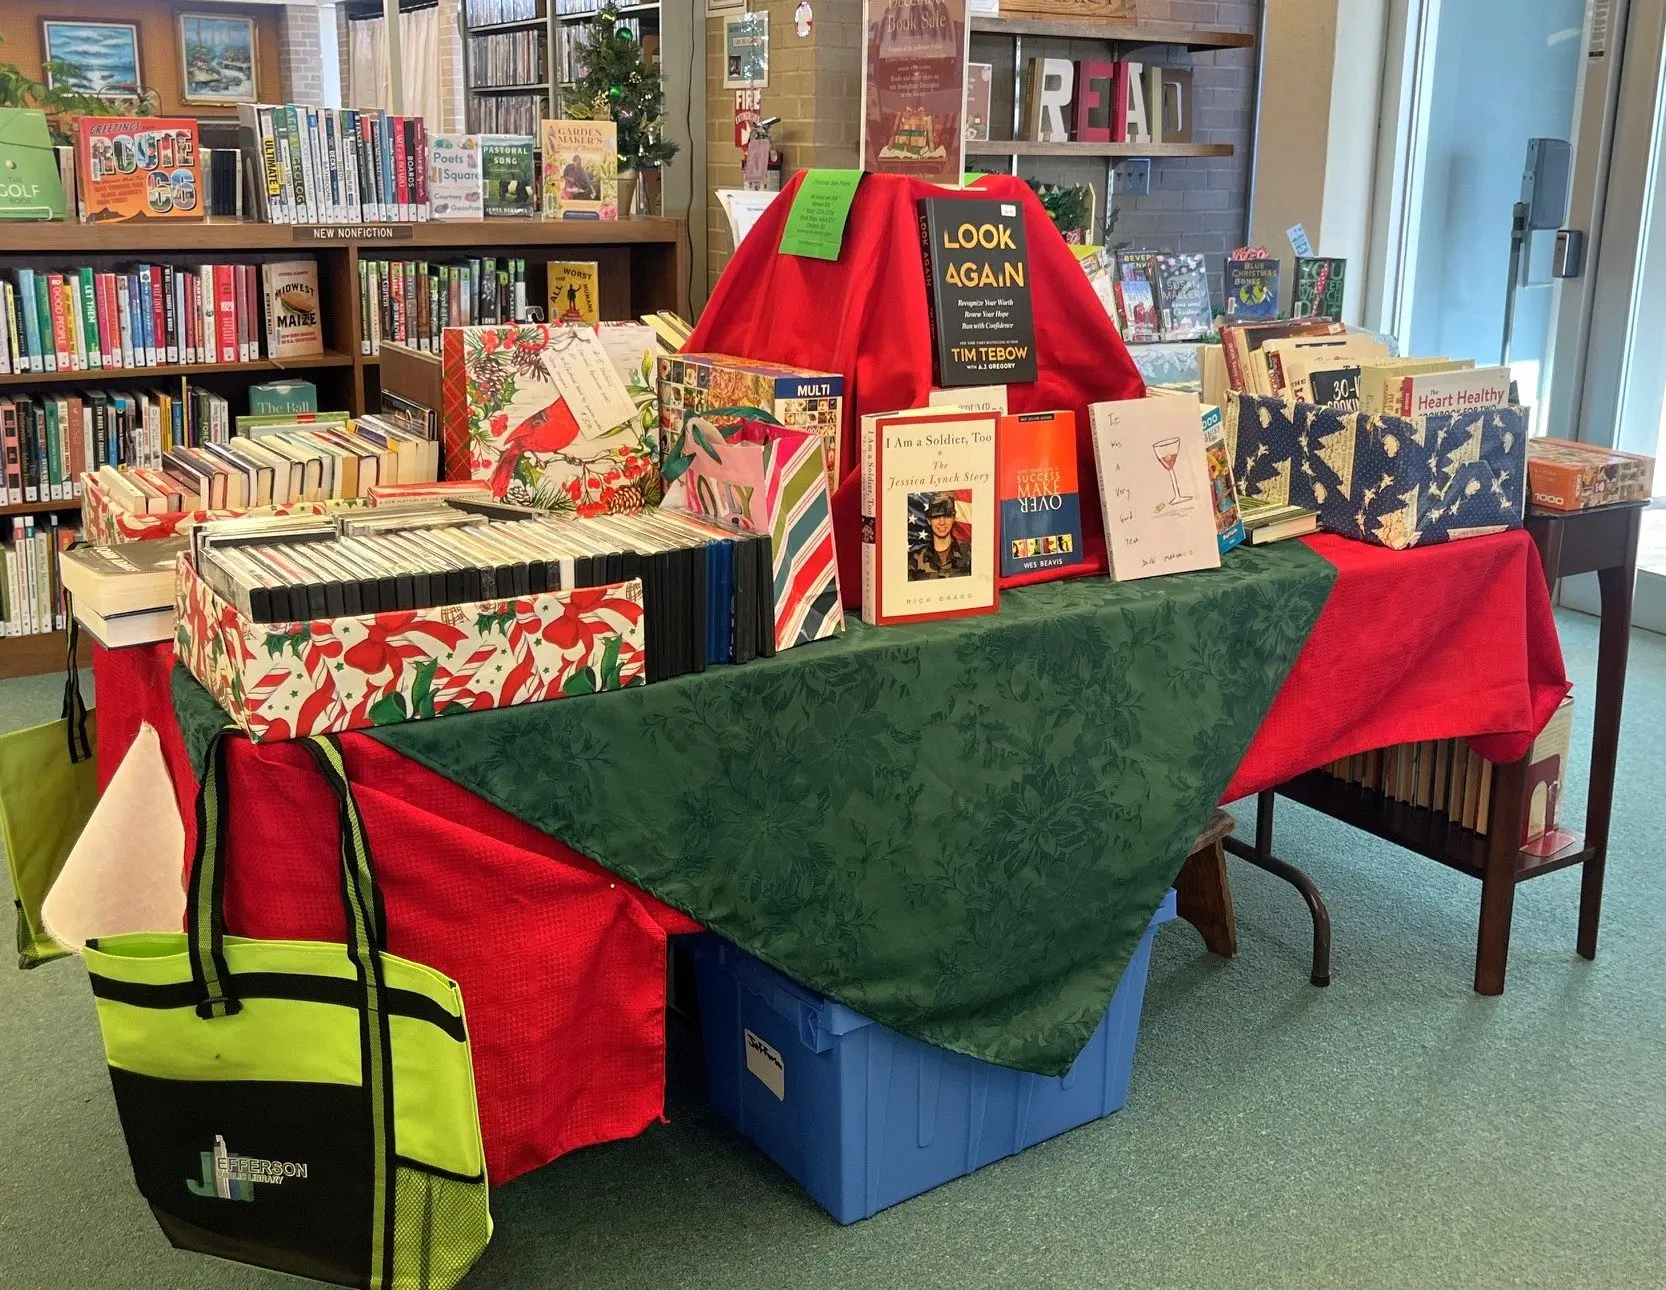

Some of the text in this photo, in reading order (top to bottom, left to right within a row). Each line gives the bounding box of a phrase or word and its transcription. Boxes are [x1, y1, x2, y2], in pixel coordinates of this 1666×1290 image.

[888, 10, 946, 32] Book Sale
[735, 88, 761, 110] FIRE
[1036, 58, 1192, 143] READ
[90, 122, 141, 134] GREETINGS
[558, 135, 603, 143] MAKER'S
[90, 128, 194, 182] ROUTE
[287, 110, 305, 206] AERIAL GEOLOG
[483, 146, 528, 155] PASTORAL
[265, 140, 277, 185] ULTIMATE
[433, 153, 464, 164] Poets
[444, 170, 480, 185] Square
[147, 169, 197, 213] 66
[434, 192, 462, 202] Courtney
[314, 228, 393, 238] NEW NONFICTION
[944, 223, 1016, 249] LOOK
[920, 215, 932, 287] LOOK AGAIN
[564, 268, 592, 280] WORST
[945, 262, 1024, 287] AGAIN
[275, 283, 314, 300] MIDWEST
[1167, 281, 1200, 289] SUSAN
[551, 285, 562, 303] ALL
[583, 284, 593, 313] HUMANS
[1161, 291, 1206, 299] MALLERY
[958, 300, 984, 308] Recognize
[53, 287, 66, 345] GOOD PEOPLE
[87, 302, 95, 323] THEM
[277, 313, 316, 327] MAIZE
[995, 311, 1009, 319] Hope
[985, 322, 1014, 330] Confidence
[951, 346, 1028, 362] TIM TEBOW
[797, 384, 830, 397] MULTI
[1291, 379, 1306, 387] THE
[1419, 394, 1453, 409] Heart
[1457, 387, 1505, 405] Healthy
[257, 401, 309, 414] The Ball
[868, 437, 874, 452] Am
[886, 432, 992, 448] I Am a Soldier, Too
[933, 461, 949, 470] The
[867, 464, 875, 494] Soldier,
[888, 472, 991, 491] Jessica Lynch Story
[1017, 472, 1060, 483] SUCCESS
[1017, 480, 1060, 498] MAKE
[1018, 494, 1062, 513] OVER
[1534, 492, 1564, 505] 1000
[1024, 559, 1063, 569] WES BEAVIS
[907, 593, 973, 605] RICK BRAGG
[248, 1173, 284, 1184] LIBRARY
